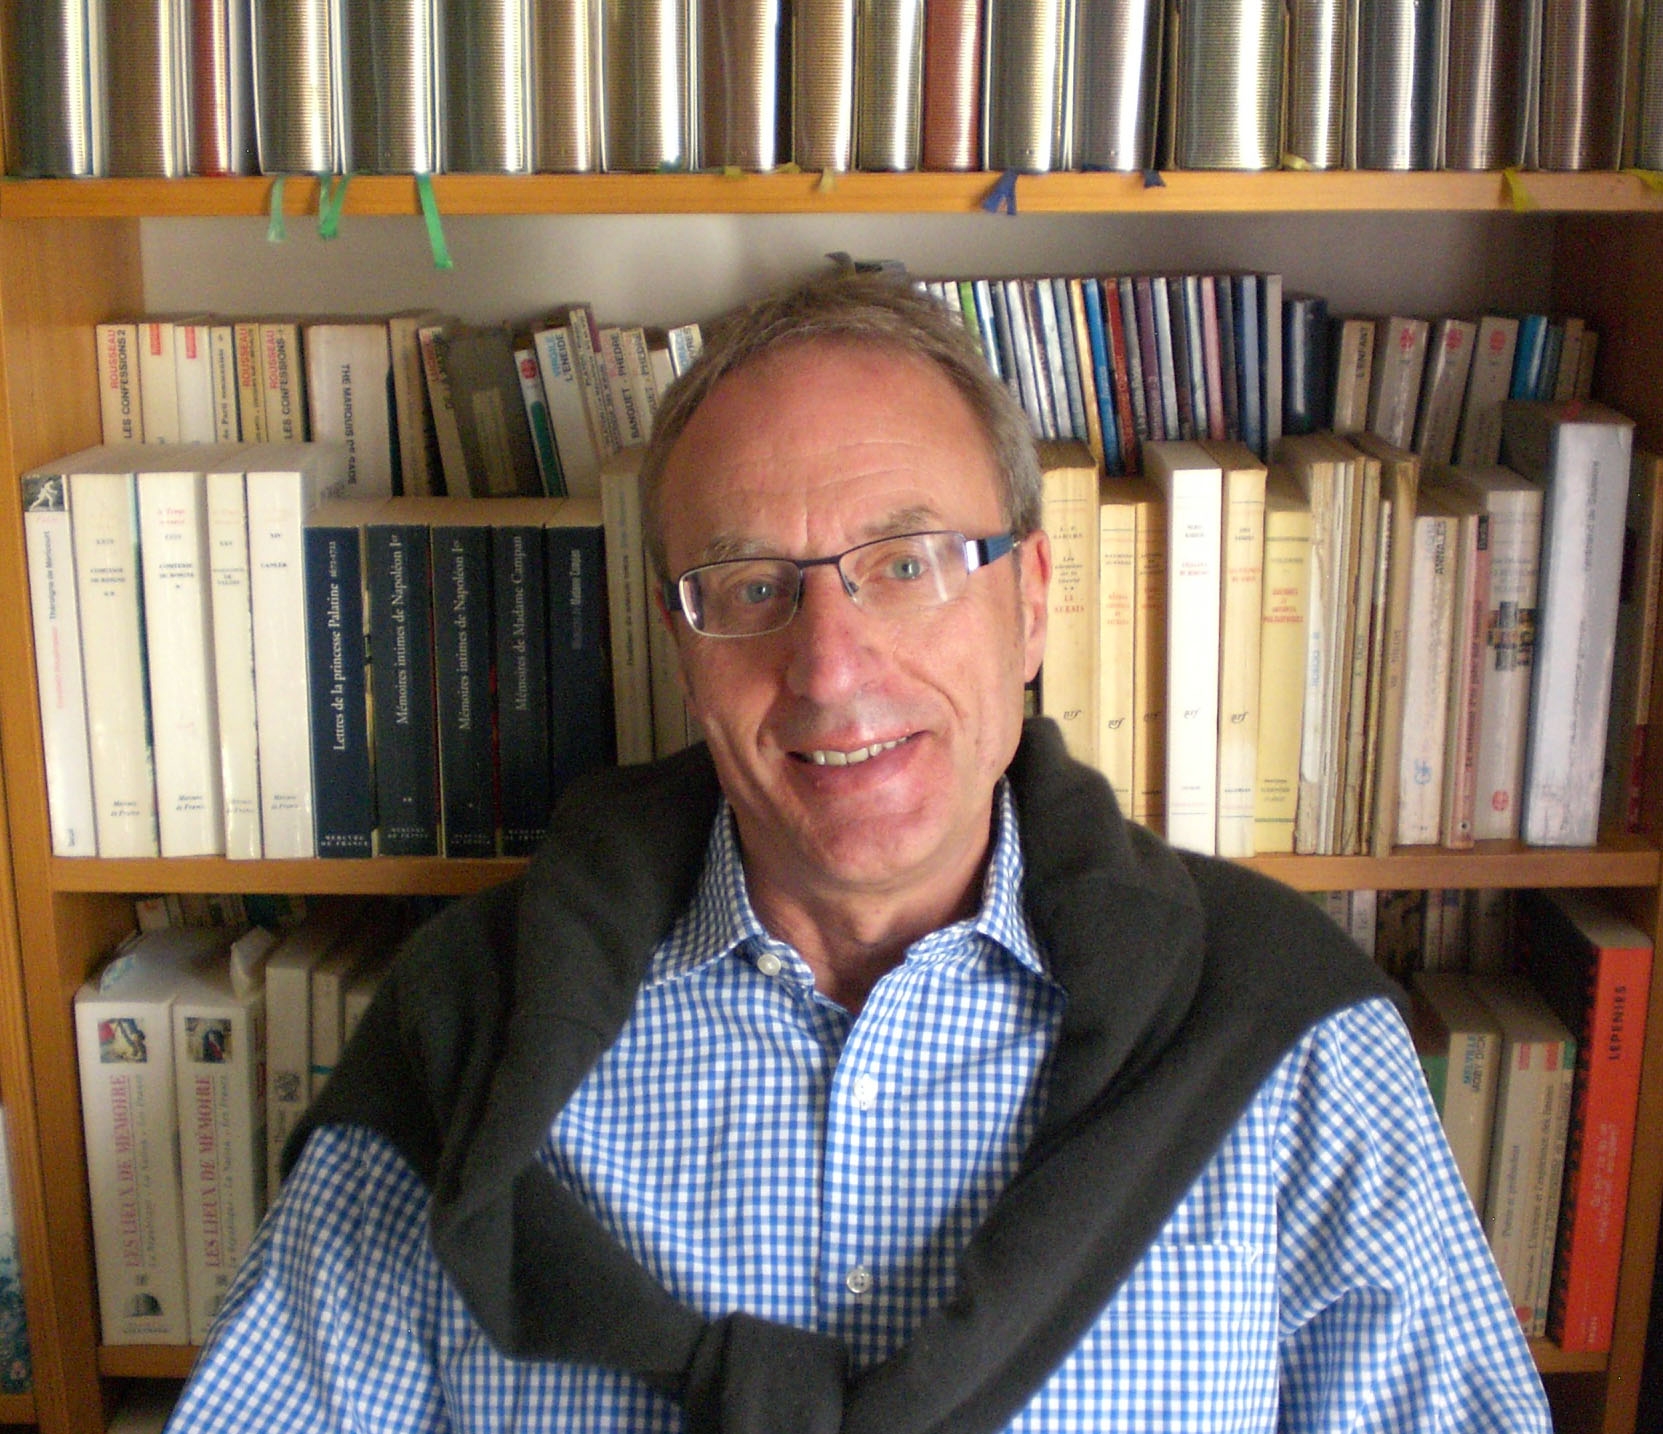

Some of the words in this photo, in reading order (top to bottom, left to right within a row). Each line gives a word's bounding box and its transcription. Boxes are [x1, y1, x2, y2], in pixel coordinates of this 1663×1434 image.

[107, 328, 119, 389] ROUSSEAU
[118, 337, 131, 416] CONFESSIONS
[239, 327, 251, 387] ROUSSEAU
[266, 329, 279, 390] ROUSSEAU
[276, 337, 291, 416] CONFESSIONS
[341, 363, 351, 385] THE
[122, 418, 132, 440] LES
[282, 418, 293, 440] LES
[343, 386, 355, 437] MARQUIS
[621, 387, 639, 439] BANQUET
[389, 551, 408, 606] Napoléon
[510, 536, 527, 584] Campan
[326, 583, 341, 628] Palatine
[451, 556, 469, 611] Napoléon
[391, 608, 405, 623] de
[453, 613, 467, 628] de
[511, 587, 526, 636] Madame
[329, 631, 346, 681] princesse
[393, 626, 407, 667] intimes
[455, 631, 469, 673] intimes
[512, 639, 526, 653] de
[330, 683, 343, 695] la
[331, 697, 344, 710] de
[394, 670, 409, 724] Mémoires
[457, 676, 472, 730] Mémoires
[514, 655, 528, 710] Mémoires
[332, 714, 346, 751] Lettres
[1063, 709, 1083, 721] nrf
[1107, 717, 1126, 730] nrf
[1231, 711, 1250, 724] nrf
[1608, 985, 1627, 1061] LEPENIES
[198, 1159, 216, 1182] DE
